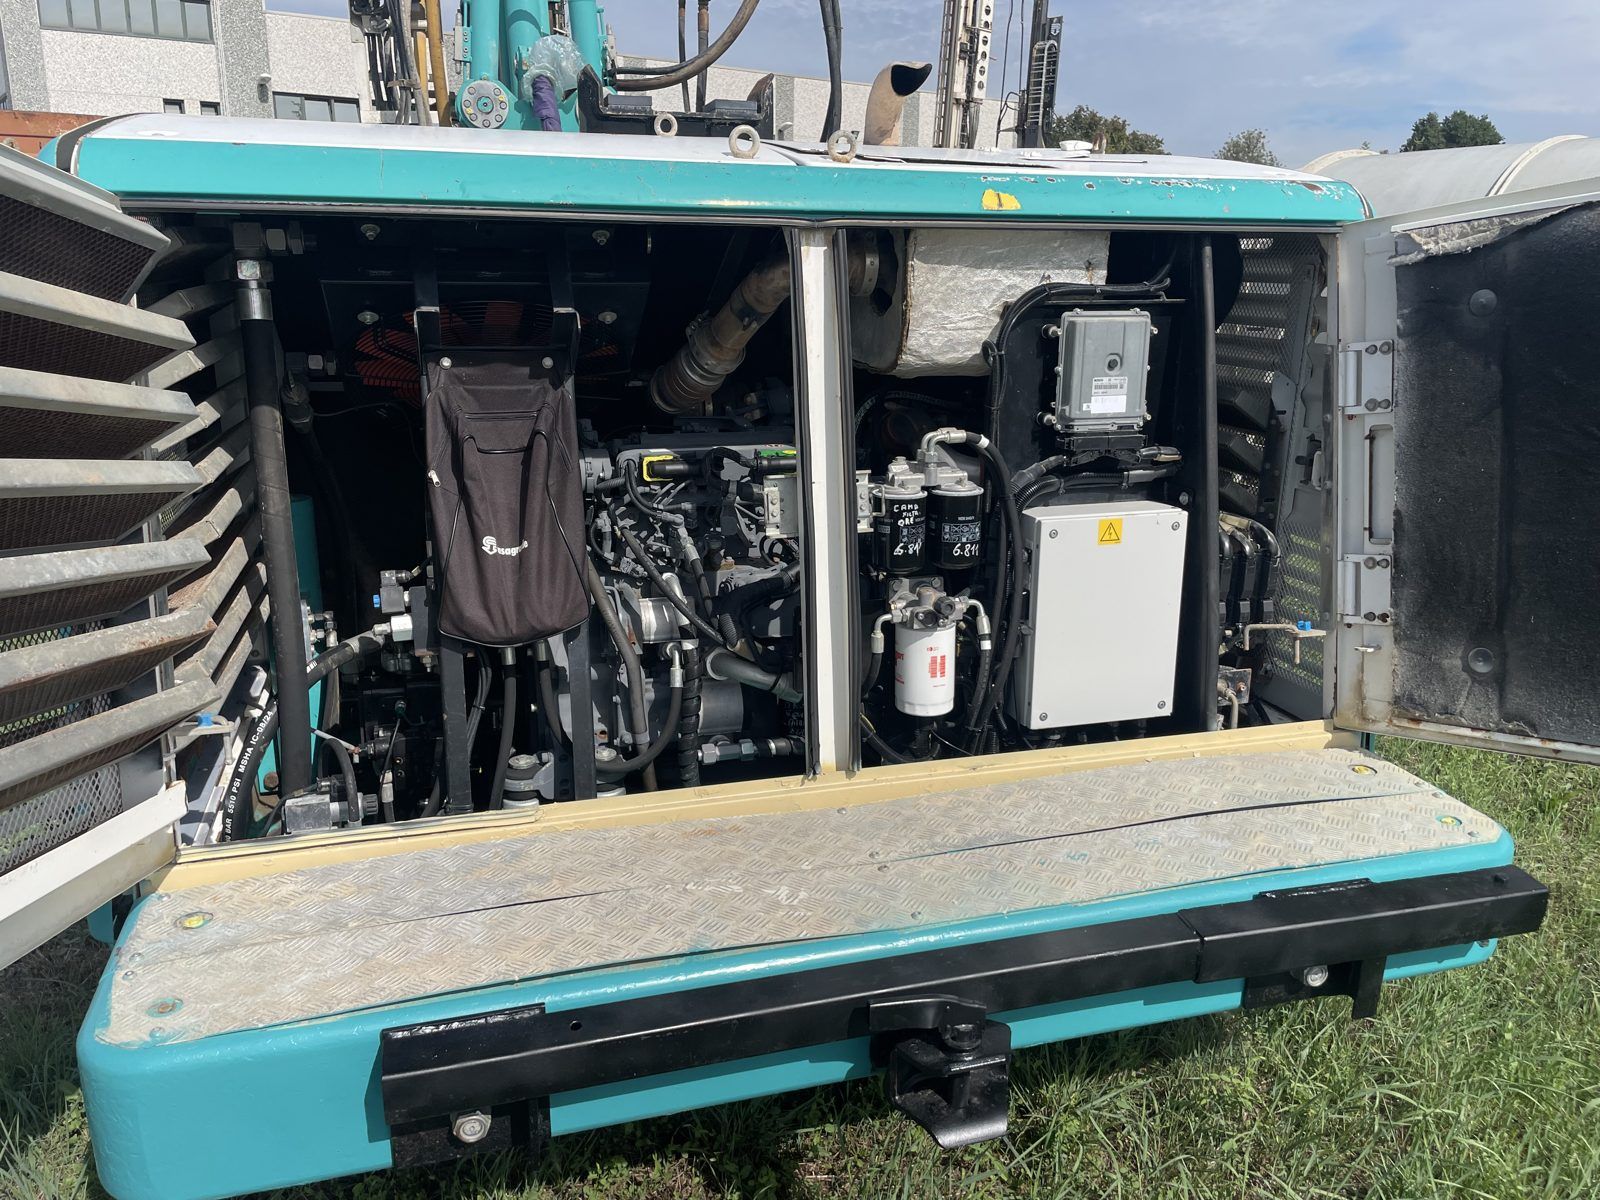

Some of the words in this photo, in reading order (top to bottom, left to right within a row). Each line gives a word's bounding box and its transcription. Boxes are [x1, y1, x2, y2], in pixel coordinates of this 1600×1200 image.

[952, 543, 979, 557] 6.811
[238, 747, 254, 774] MSHA
[231, 778, 242, 794] PSI
[227, 795, 236, 814] 5510
[225, 818, 233, 835] BAR
